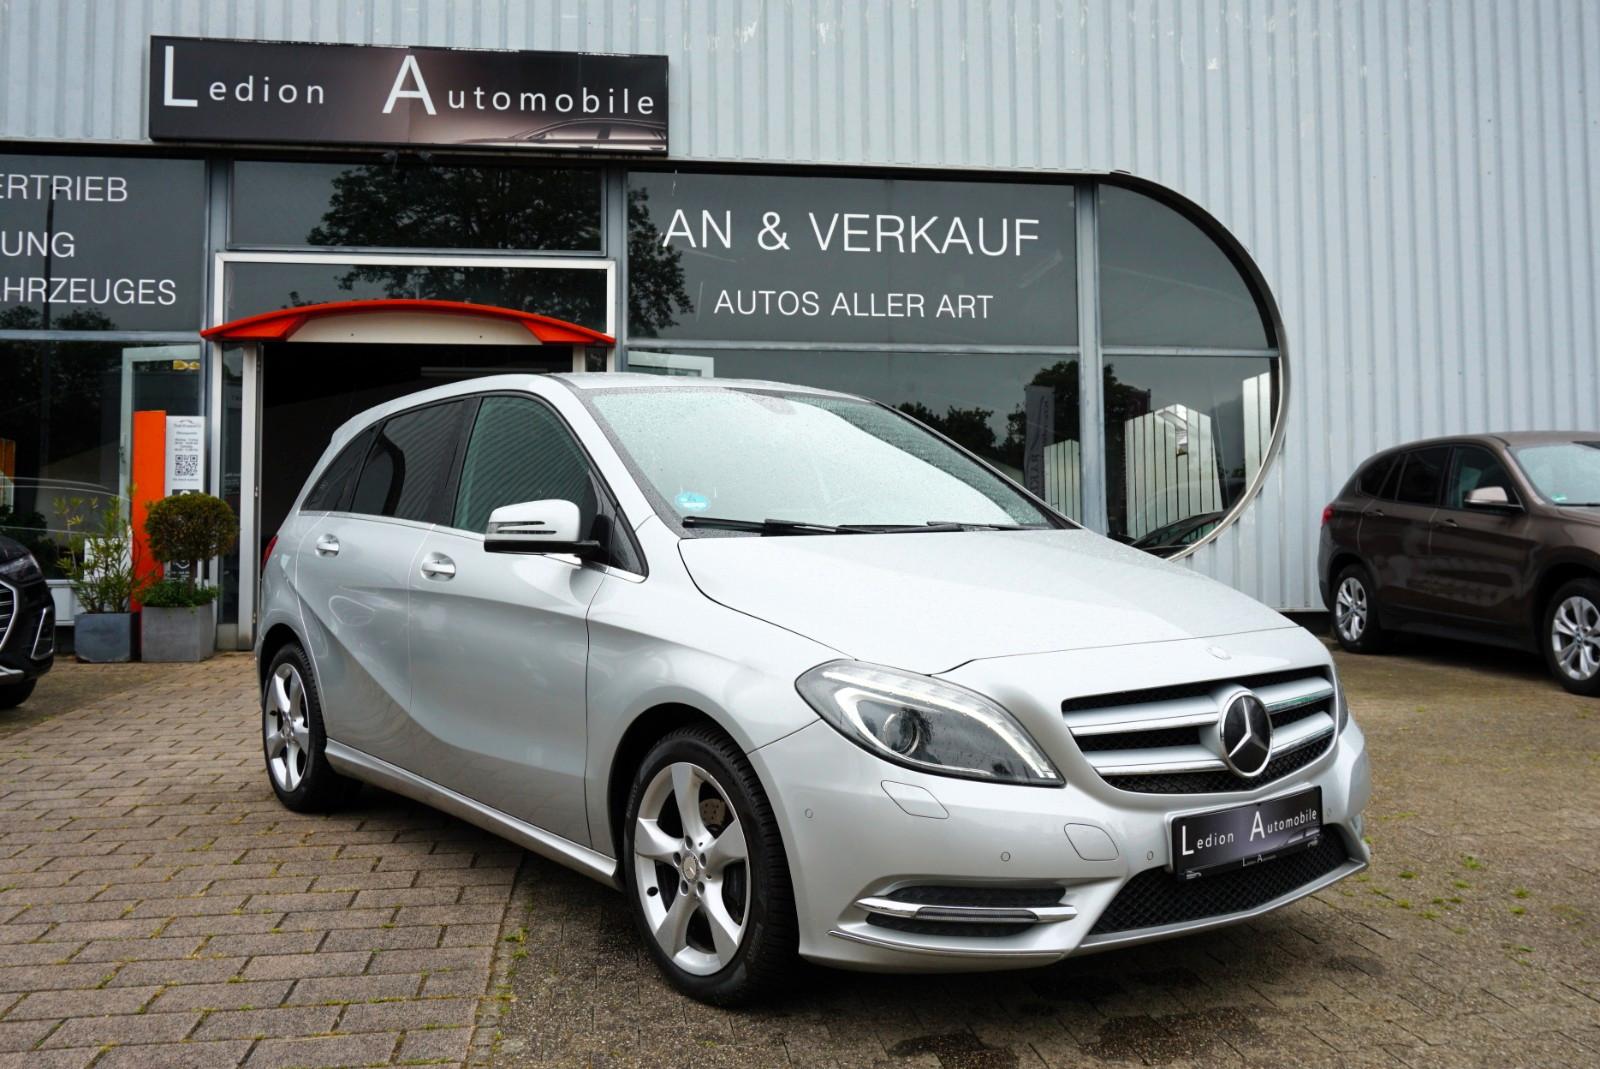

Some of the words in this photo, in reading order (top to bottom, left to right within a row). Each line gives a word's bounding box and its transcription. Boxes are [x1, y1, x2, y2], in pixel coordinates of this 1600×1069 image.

[164, 45, 324, 107] Ledion
[382, 55, 654, 115] Automobile
[0, 173, 128, 202] RTRIEB
[1, 230, 75, 258] UNG
[662, 208, 731, 249] AN
[757, 211, 790, 251] &
[809, 212, 1039, 256] VERKAUF
[0, 276, 177, 306] HRZEUGES
[714, 289, 820, 317] AUTOS
[831, 291, 925, 318] ALLER
[936, 294, 994, 319] ART
[1182, 825, 1234, 856] Ledion
[1249, 808, 1317, 842] Automobile
